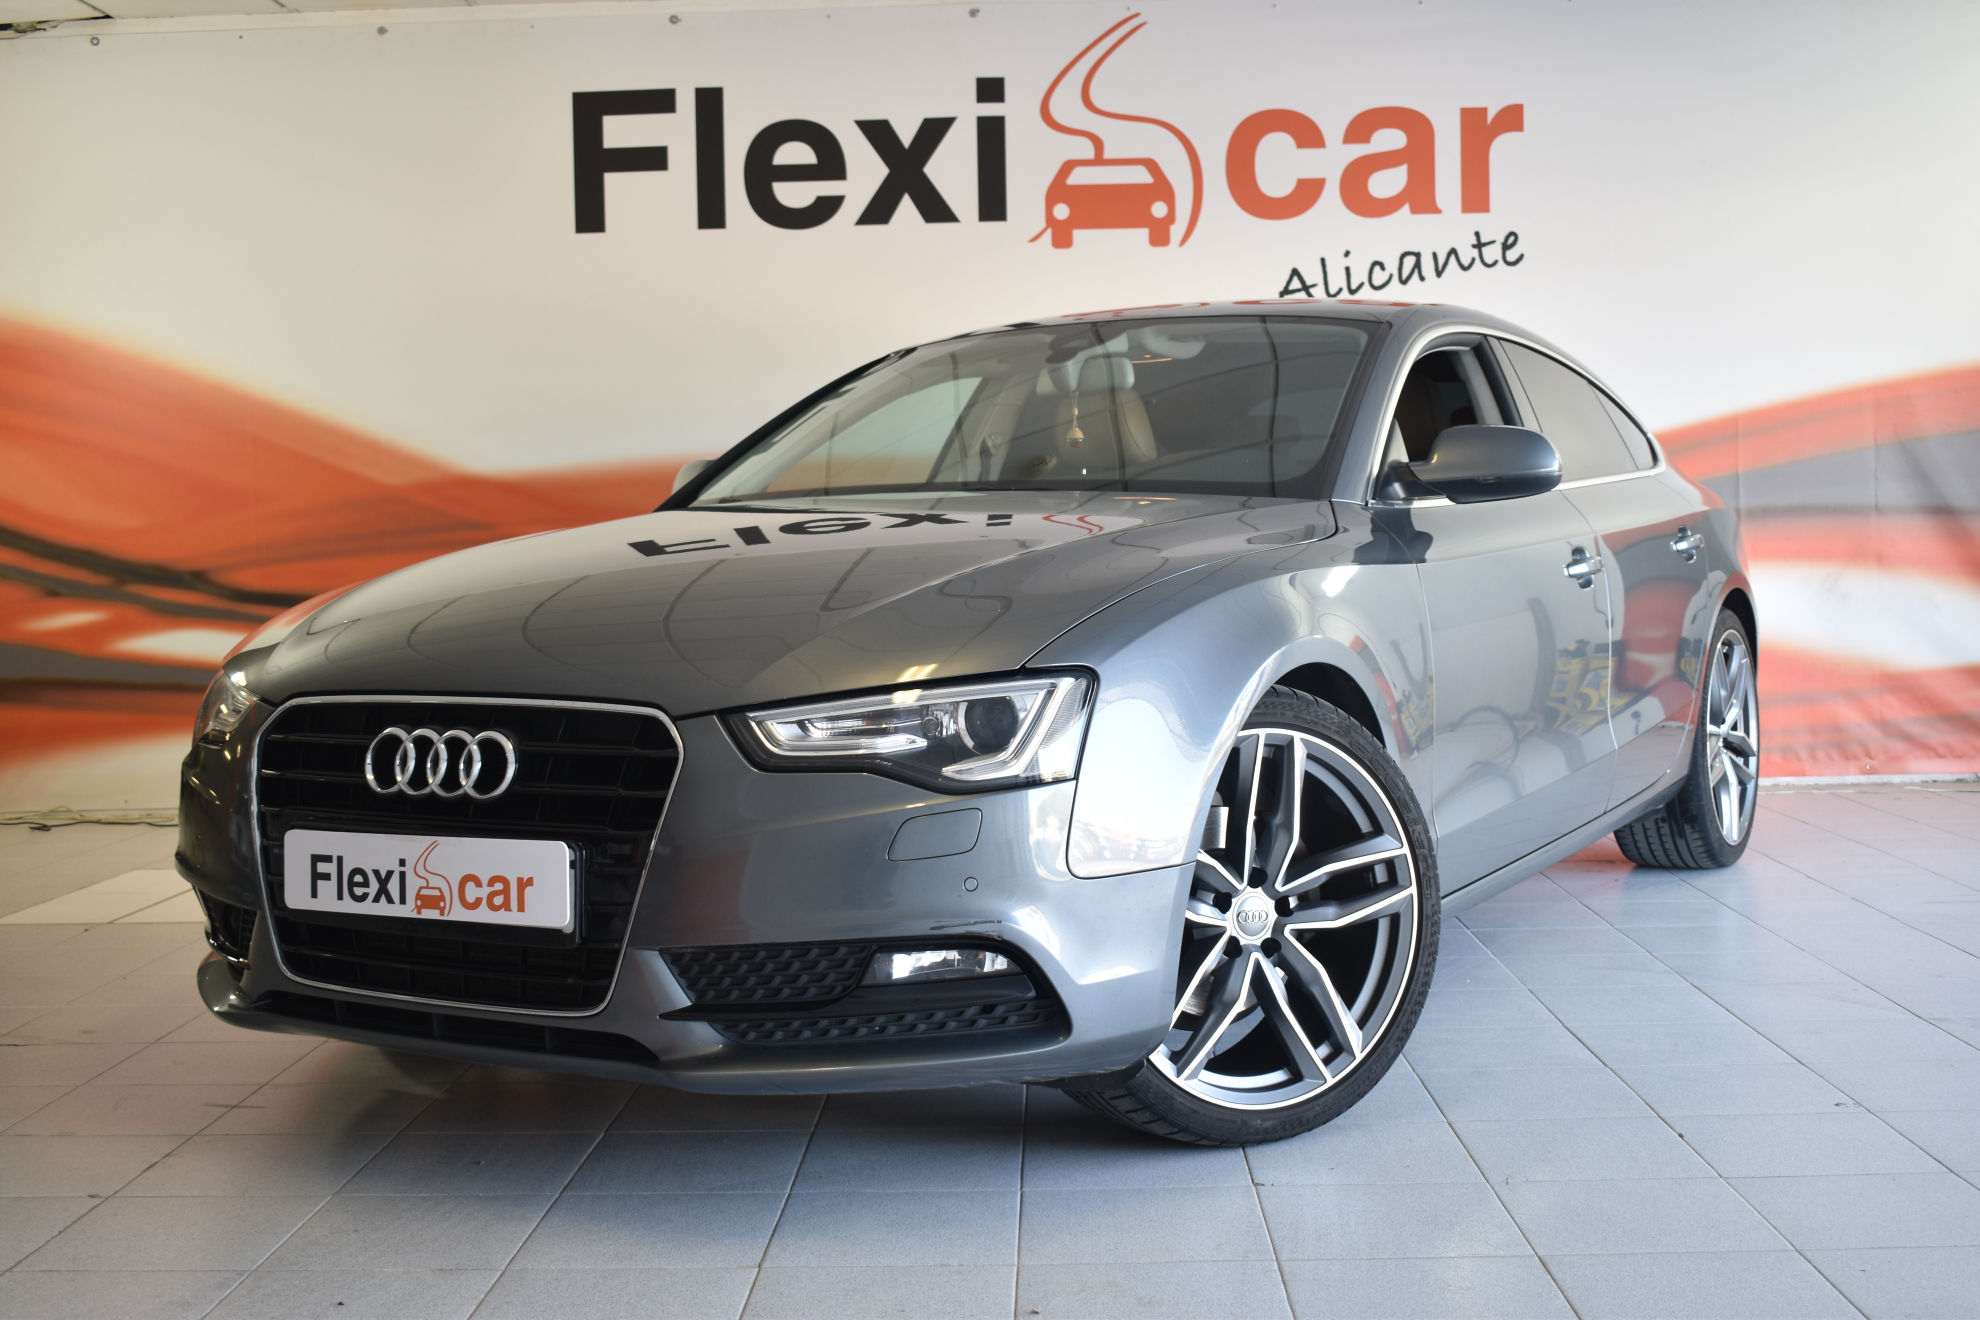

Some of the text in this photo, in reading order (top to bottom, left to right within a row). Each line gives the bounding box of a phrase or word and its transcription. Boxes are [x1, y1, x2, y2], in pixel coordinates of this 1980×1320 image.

[572, 77, 1524, 234] Flexi car
[1279, 230, 1524, 298] Alicante
[310, 853, 534, 913] Flexi car
